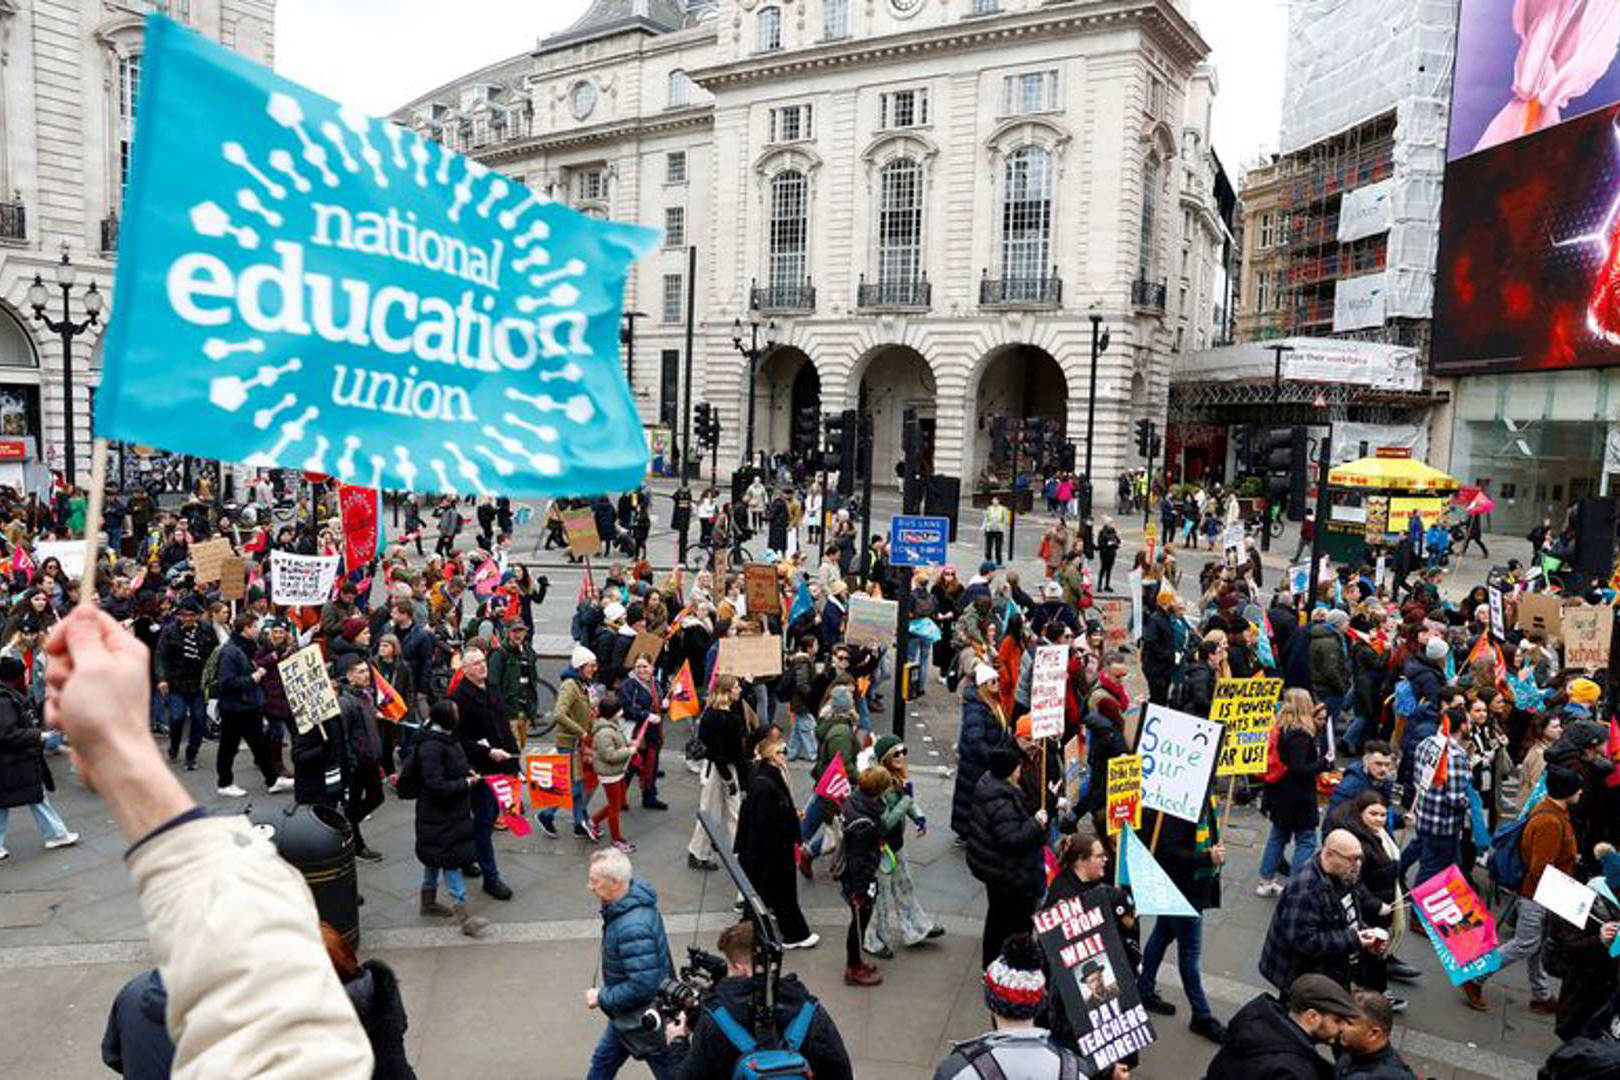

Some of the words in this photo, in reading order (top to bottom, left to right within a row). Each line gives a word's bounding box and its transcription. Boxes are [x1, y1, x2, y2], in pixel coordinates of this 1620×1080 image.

[311, 200, 502, 291] national
[166, 240, 593, 373] education
[331, 363, 478, 423] union
[1216, 681, 1281, 699] KNOWLEDGE
[1219, 703, 1232, 718] IS
[1236, 699, 1274, 716] POWER
[1142, 717, 1201, 766] Save
[1241, 746, 1265, 764] US!
[531, 762, 552, 788] UP
[1033, 896, 1084, 934] LEARN
[1062, 906, 1105, 940] FROM
[1421, 886, 1464, 925] UP
[1059, 933, 1106, 968] WALT
[1077, 1002, 1150, 1056] TEACHERS
[1088, 997, 1122, 1030] PAY
[1093, 1024, 1154, 1071] MORE!!!
